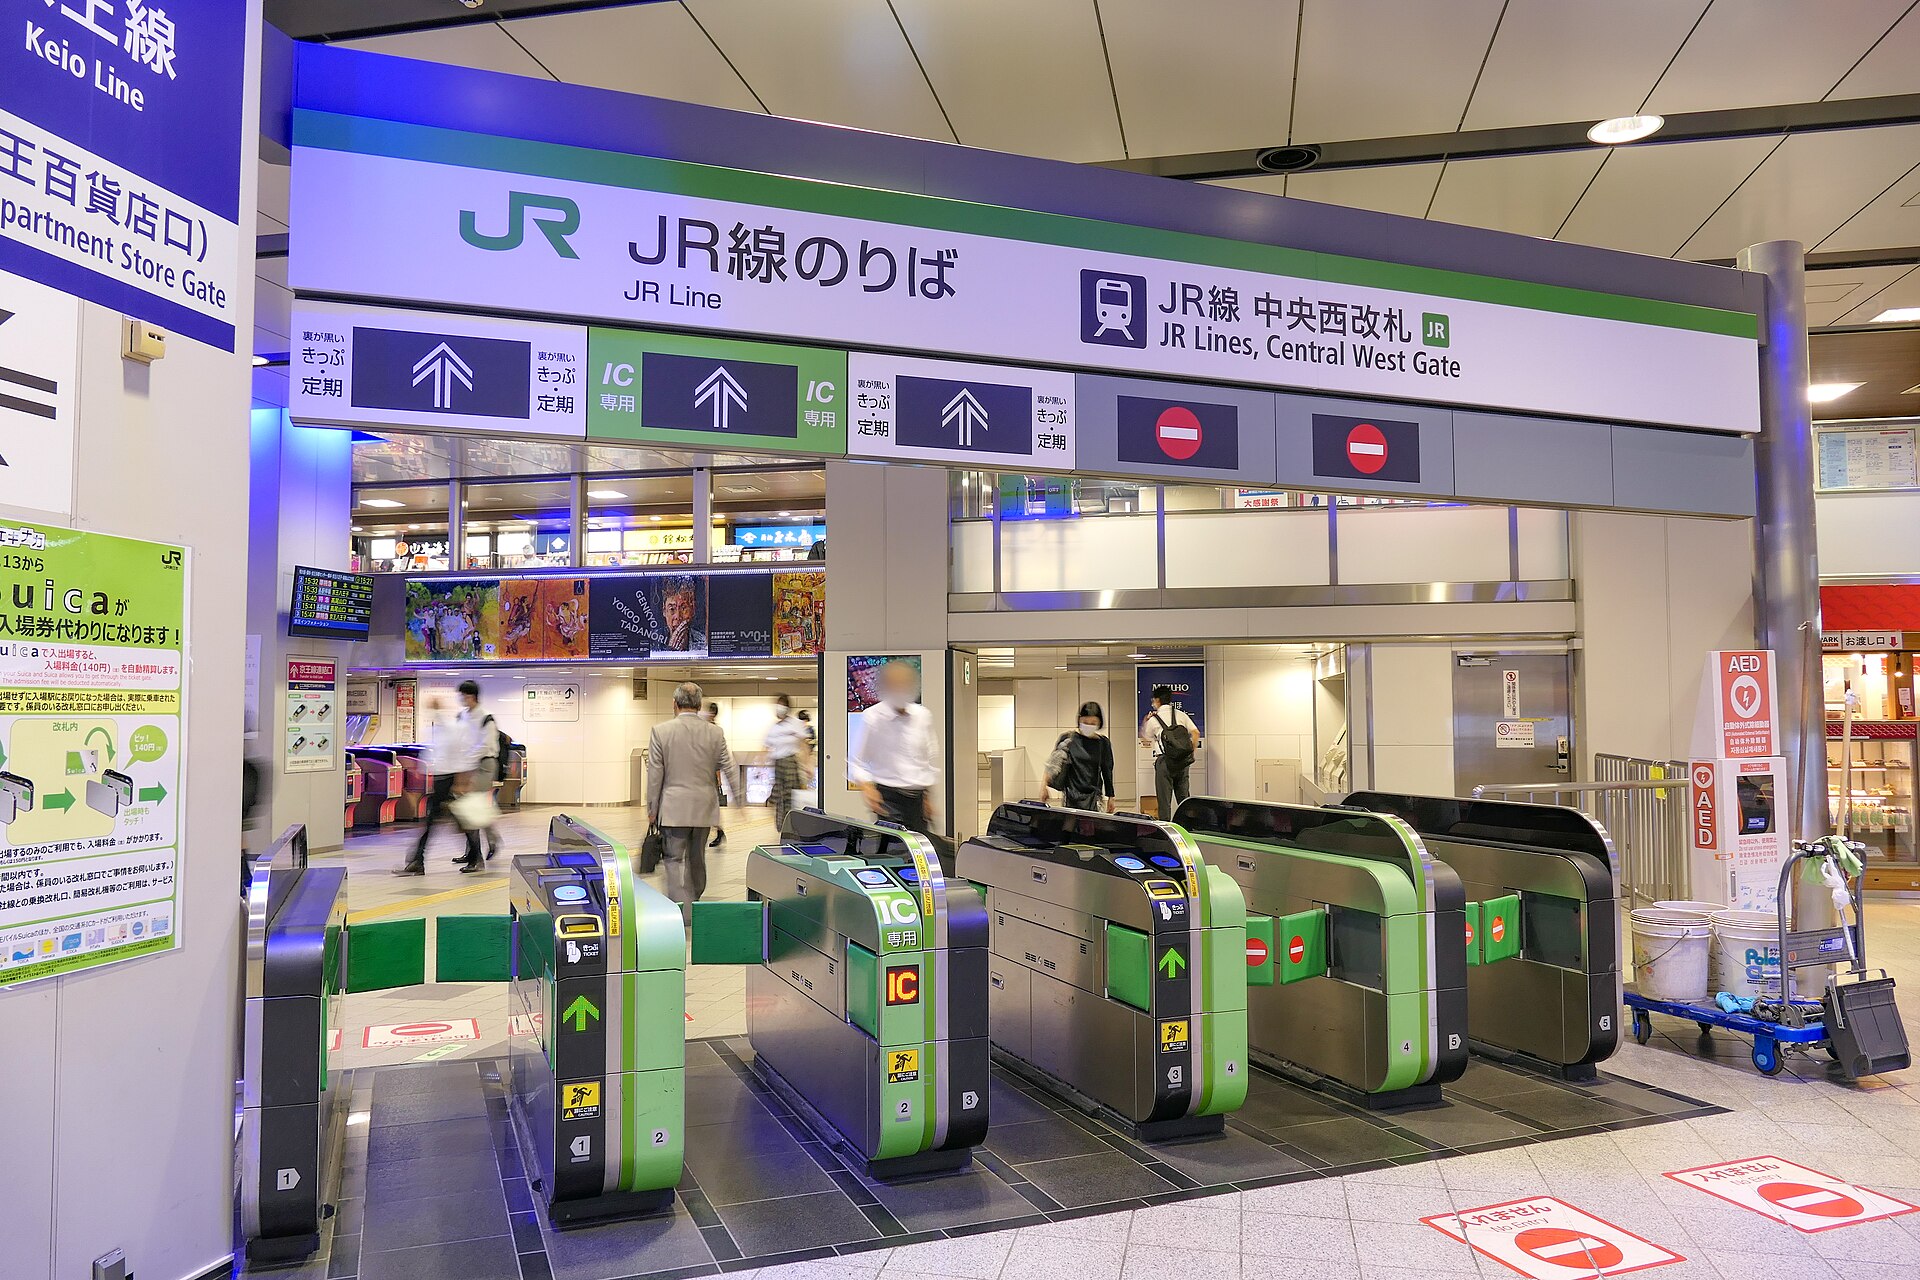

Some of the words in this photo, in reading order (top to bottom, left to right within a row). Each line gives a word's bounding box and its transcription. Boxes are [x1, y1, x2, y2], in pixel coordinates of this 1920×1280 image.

[26, 20, 86, 78] Keio
[95, 59, 144, 111] Line
[459, 191, 580, 260] JR
[0, 197, 114, 265] partment
[121, 243, 175, 288] Store
[182, 270, 226, 308] Gate
[628, 215, 958, 299] JR線のりば
[623, 280, 660, 303] JR
[670, 284, 722, 310] Line
[1158, 282, 1241, 323] JR線
[1253, 290, 1412, 343] 中央西改札
[302, 331, 345, 344] 裏が黒い
[1426, 320, 1445, 339] JR
[301, 347, 345, 366] きっぷ
[537, 350, 576, 363] 裏が黒い
[1159, 322, 1185, 348] JR
[1194, 326, 1259, 360] Lines,
[1266, 335, 1345, 366] Central
[1352, 344, 1405, 373] West
[1413, 351, 1461, 378] Gate
[537, 366, 576, 385] きっぷ
[602, 363, 635, 386] IC
[301, 377, 343, 398] 定期
[805, 380, 835, 402] IC
[857, 379, 890, 390] 裏が黒い
[537, 394, 574, 414] 定期
[599, 394, 635, 413] 専用
[857, 392, 890, 410] きっぷ
[1037, 394, 1067, 405] 裏が黒い
[803, 410, 836, 428] 専用
[1036, 407, 1067, 425] きっぷ
[857, 419, 889, 437] 定期
[1037, 432, 1066, 451] 定期
[162, 551, 181, 566] JR
[611, 597, 640, 624] YOKOO
[635, 590, 658, 629] GENKYO
[620, 619, 668, 645] TADANORI
[1845, 636, 1885, 646] お渡し口
[1728, 655, 1760, 673] AED
[52, 722, 78, 731] 改札内
[1696, 791, 1713, 846] AED
[880, 896, 917, 925] IC
[582, 943, 599, 952] きっぷ
[887, 931, 917, 948] 専用
[888, 970, 917, 1001] IC
[1602, 1017, 1608, 1028] 5
[1403, 1042, 1410, 1052] 4
[1451, 1036, 1457, 1047] 5
[1171, 1068, 1179, 1080] 3
[1226, 1062, 1235, 1074] 4
[900, 1101, 908, 1114] 2
[965, 1094, 973, 1106] 3
[578, 1140, 585, 1152] 1
[655, 1131, 664, 1143] 2
[283, 1172, 290, 1184] 1
[1692, 1162, 1780, 1182] 入れません
[1452, 1204, 1551, 1229] 入れません
[1489, 1222, 1509, 1233] No
[1510, 1217, 1549, 1231] Entry
